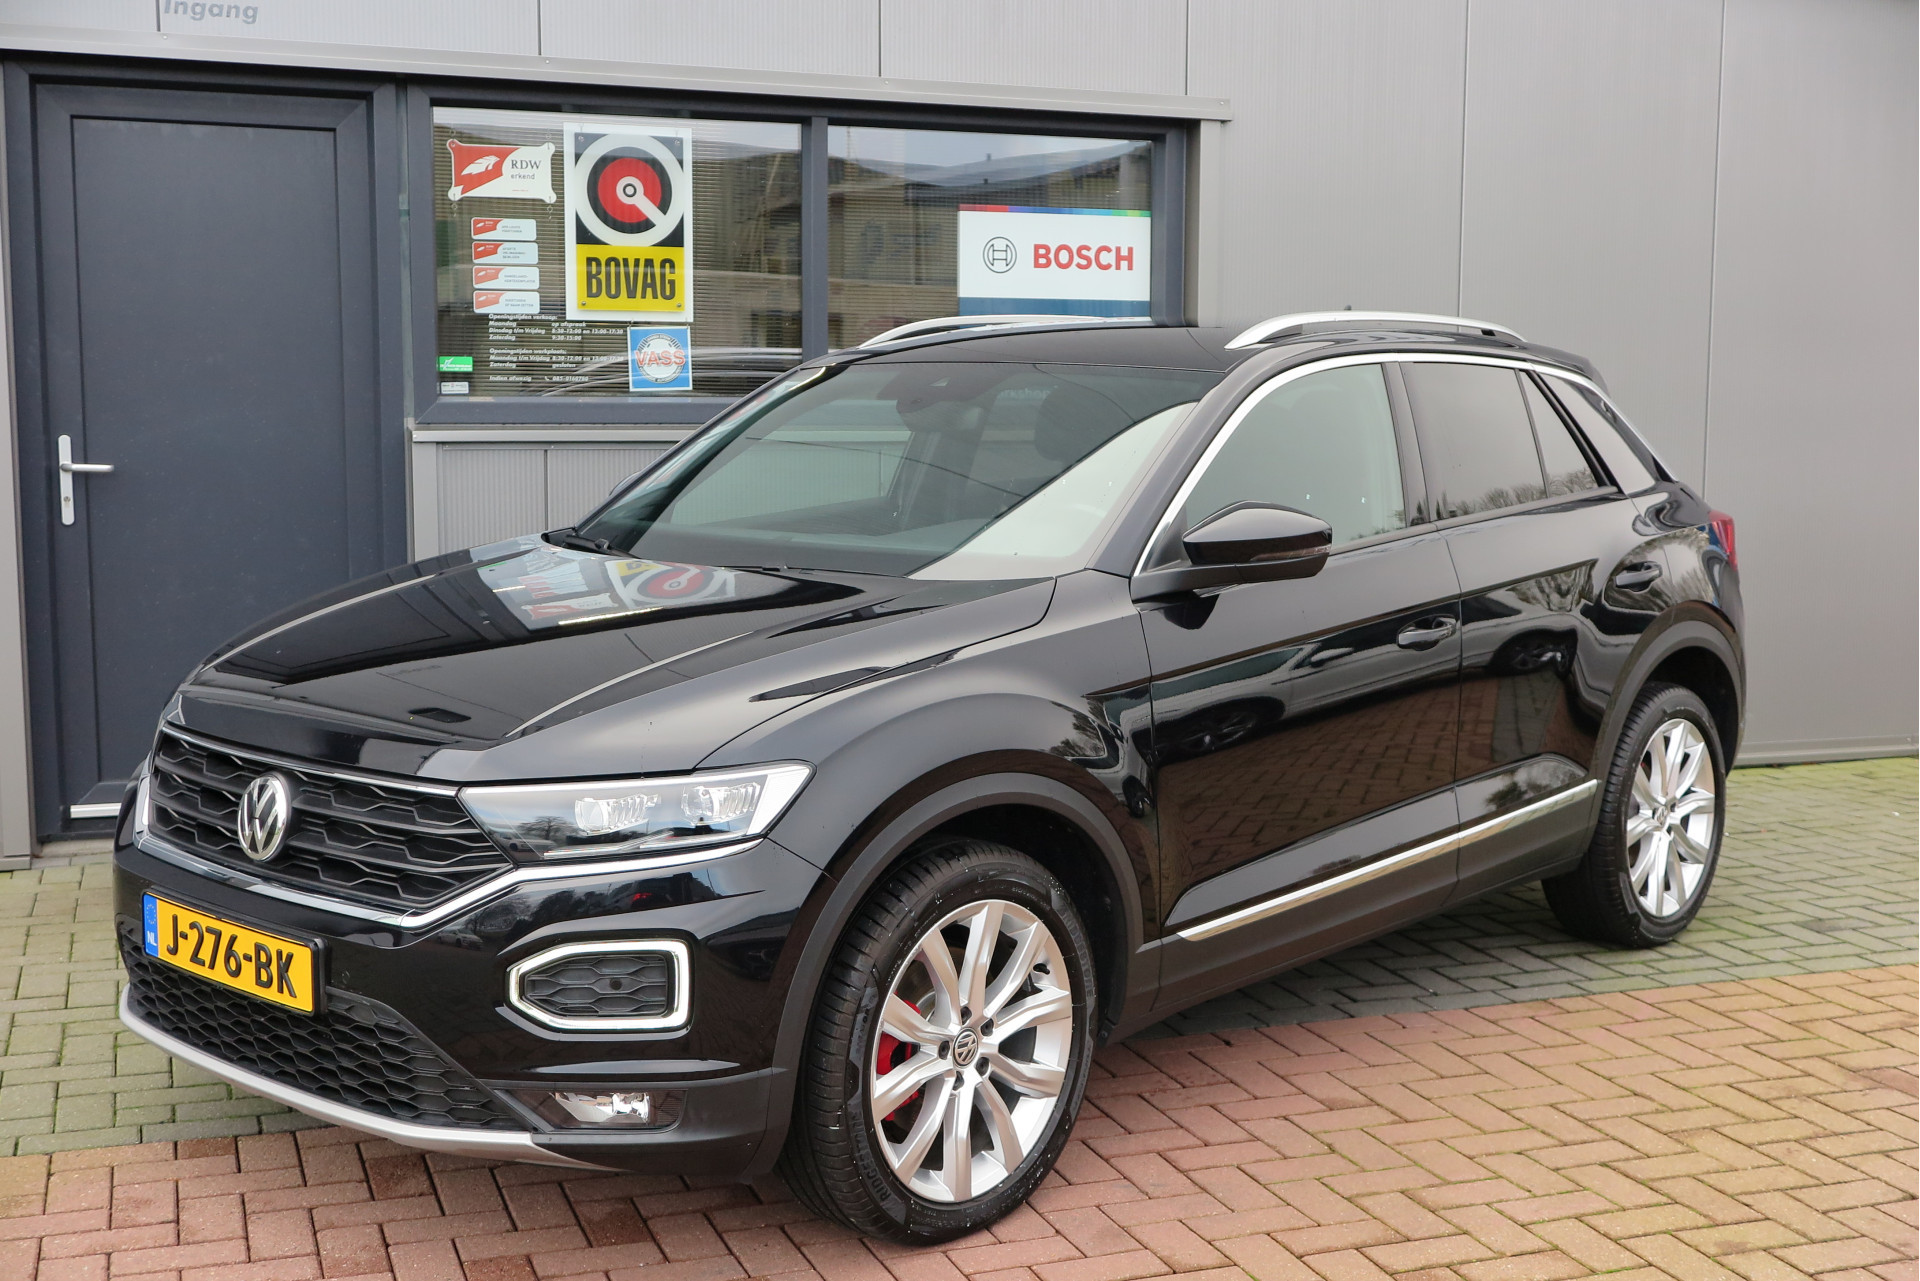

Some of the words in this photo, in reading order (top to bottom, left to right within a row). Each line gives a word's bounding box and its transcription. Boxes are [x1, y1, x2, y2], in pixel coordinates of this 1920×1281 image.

[164, 0, 259, 25] Ingang
[511, 159, 542, 170] RDW
[510, 172, 536, 180] erkend
[1033, 243, 1134, 271] BOSCH
[585, 256, 676, 301] BOVAG
[489, 313, 532, 321] Openingstijden
[488, 320, 517, 328] Maandag
[488, 327, 513, 335] Dinsdag
[488, 334, 516, 342] Zaterdag
[489, 347, 533, 355] Openingstijden
[489, 354, 518, 362] Maandag
[634, 349, 686, 367] VASS
[489, 361, 517, 369] Zaterdag
[146, 930, 158, 947] NL
[166, 913, 298, 999] J-276-BK
